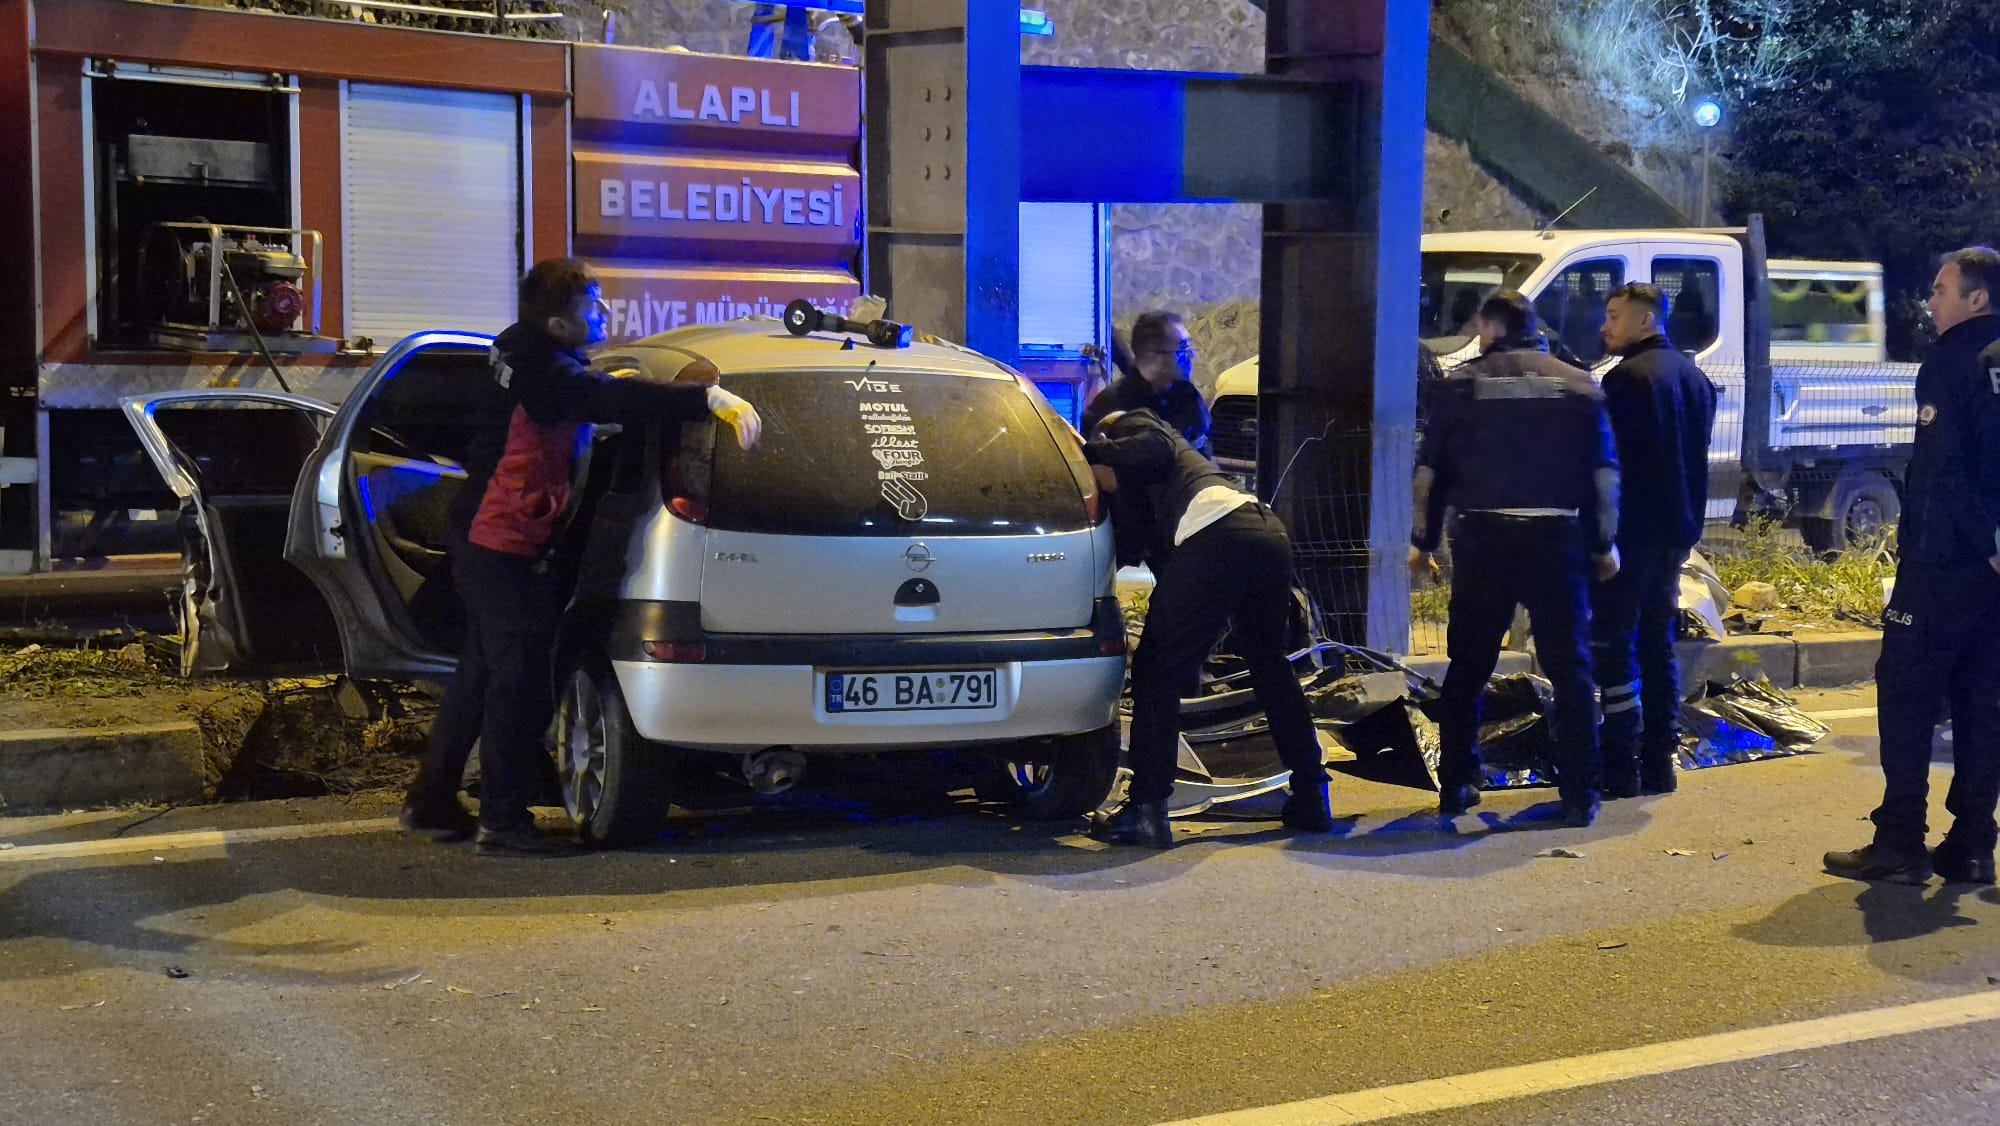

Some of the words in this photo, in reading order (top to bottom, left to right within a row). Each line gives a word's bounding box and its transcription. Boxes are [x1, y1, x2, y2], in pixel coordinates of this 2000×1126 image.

[633, 79, 800, 127] ALAPLI
[600, 177, 844, 226] BELEDİYESİ
[859, 402, 909, 412] MOTUL
[871, 436, 919, 448] illest
[883, 450, 921, 460] FOUR
[845, 676, 879, 706] 46
[895, 675, 934, 705] BA
[950, 674, 992, 704] 791
[831, 694, 842, 704] TR
